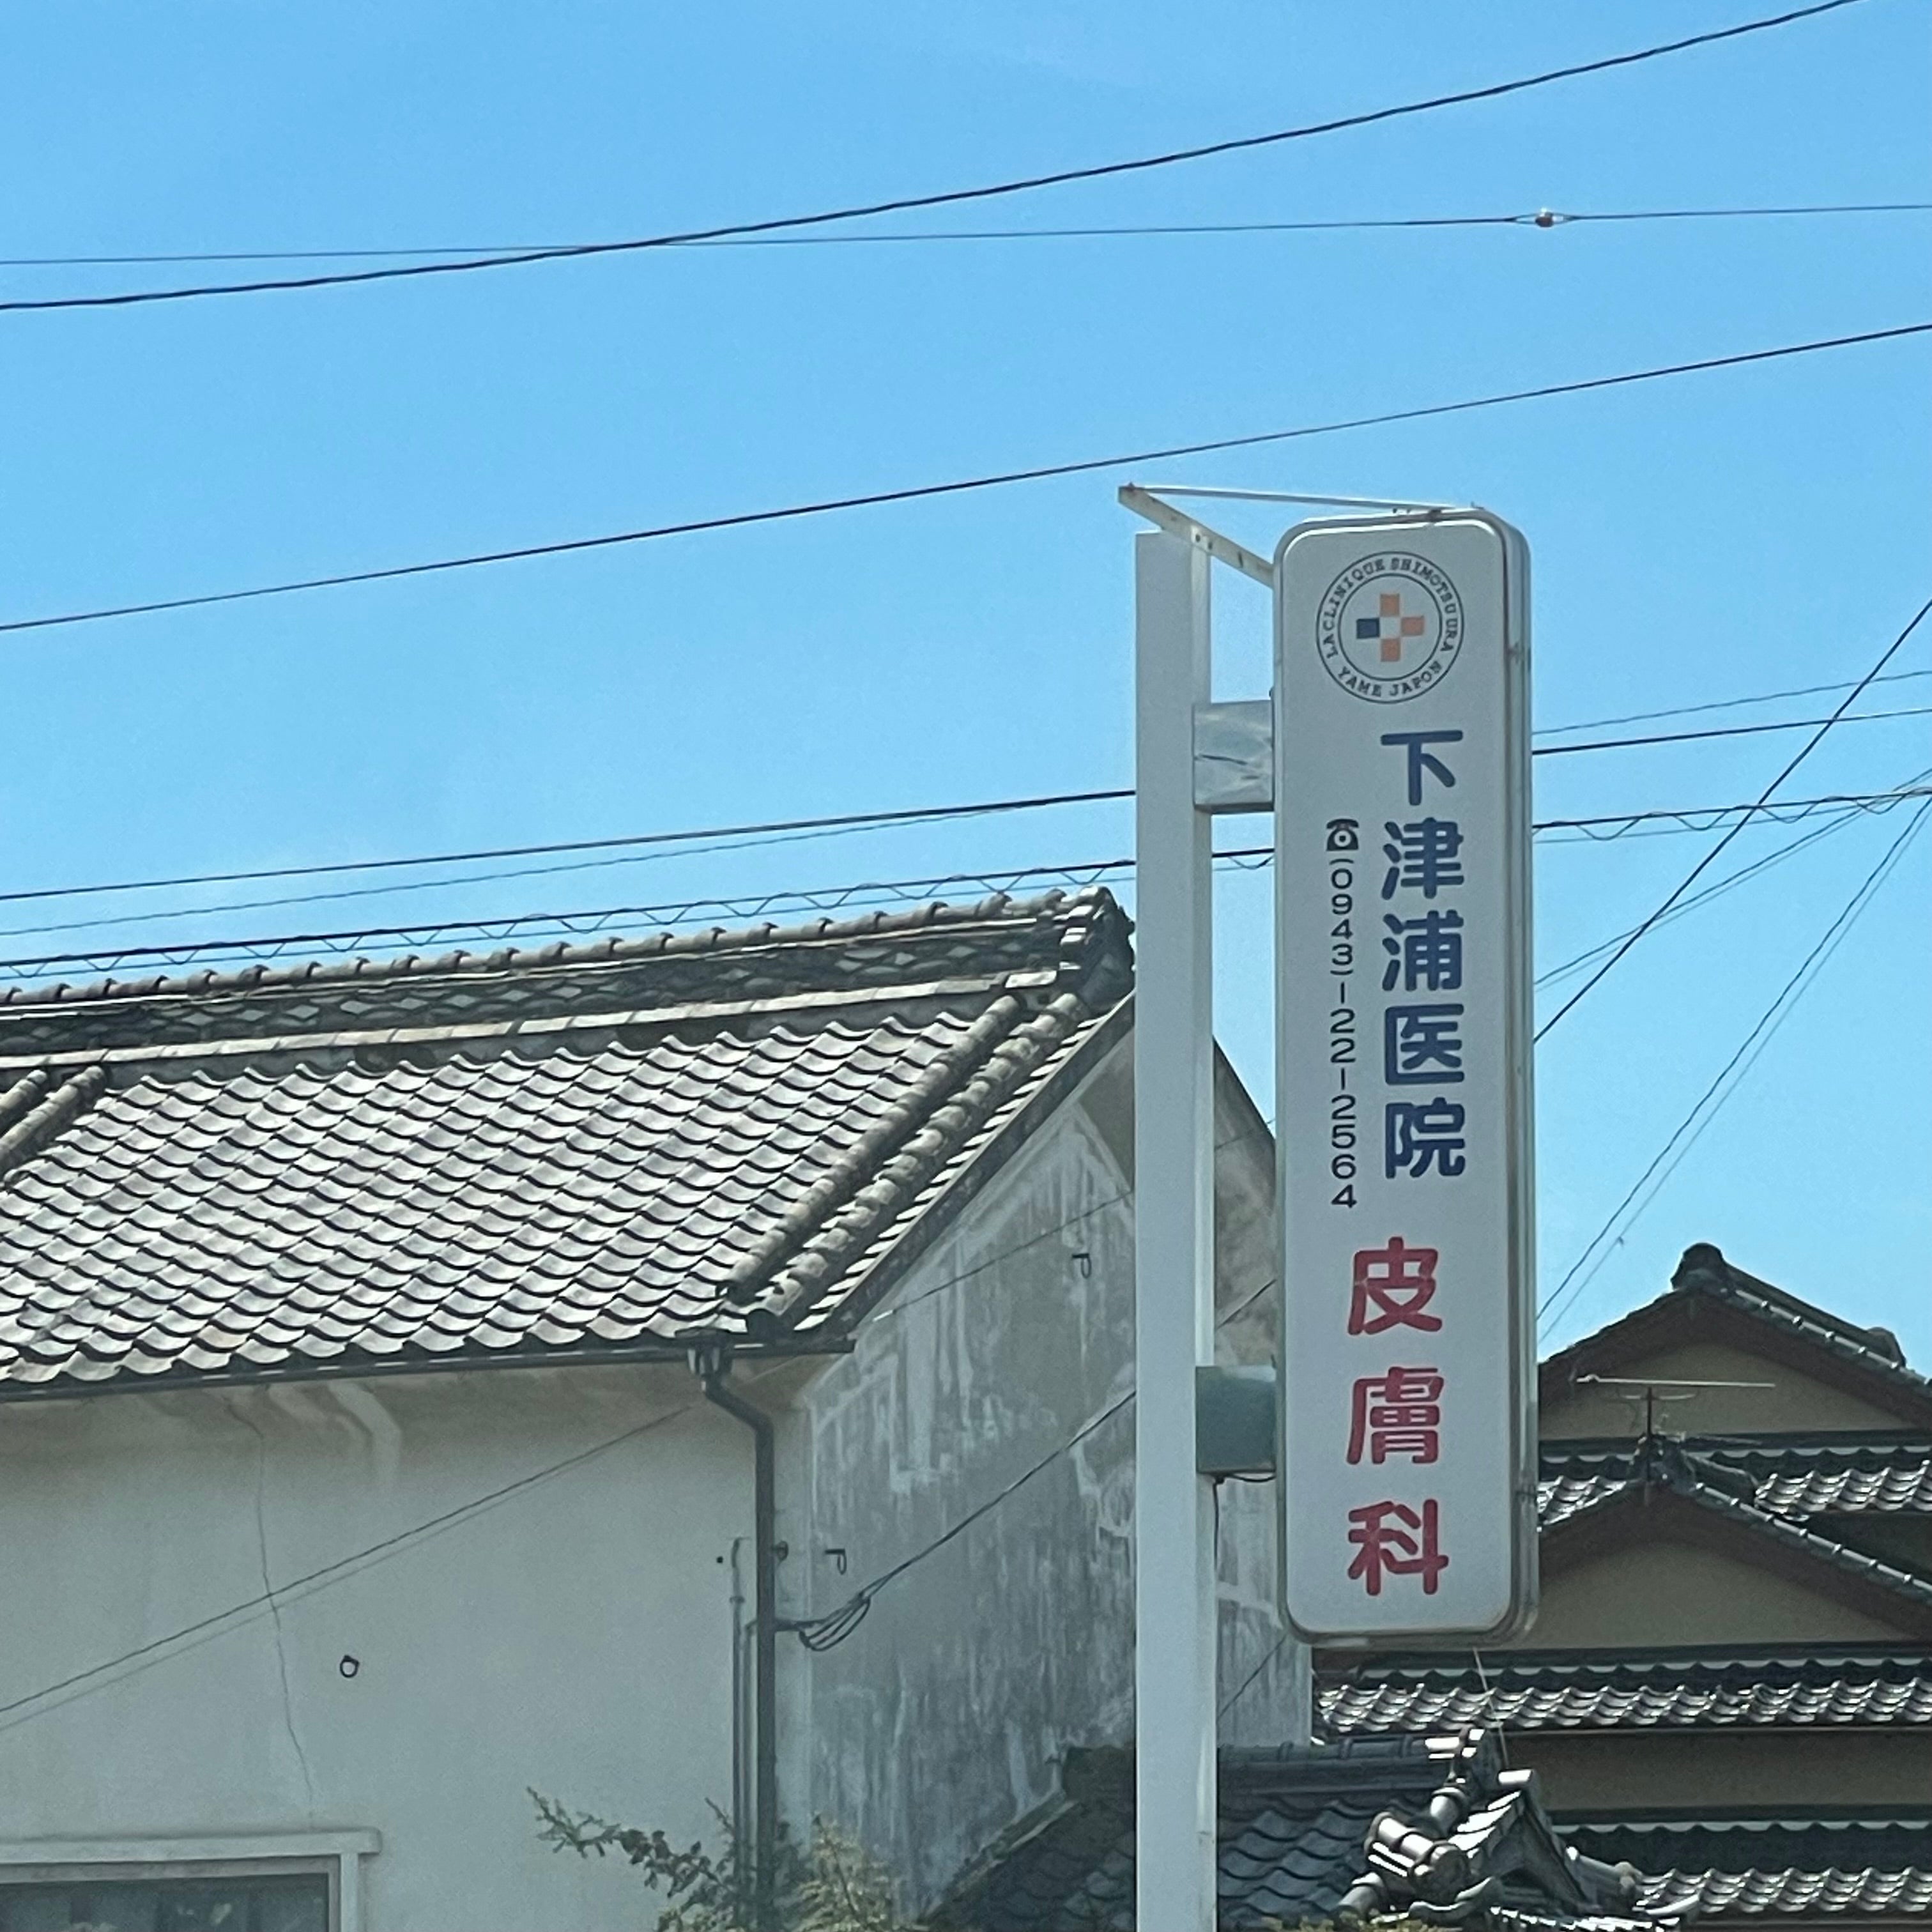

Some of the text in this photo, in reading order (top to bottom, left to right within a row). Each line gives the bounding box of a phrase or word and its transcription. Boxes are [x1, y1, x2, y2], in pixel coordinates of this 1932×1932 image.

[1337, 660, 1443, 698] YAME JAPON
[1380, 730, 1466, 1179] 下津浦医院
[1347, 1237, 1448, 1596] 皮膚科
